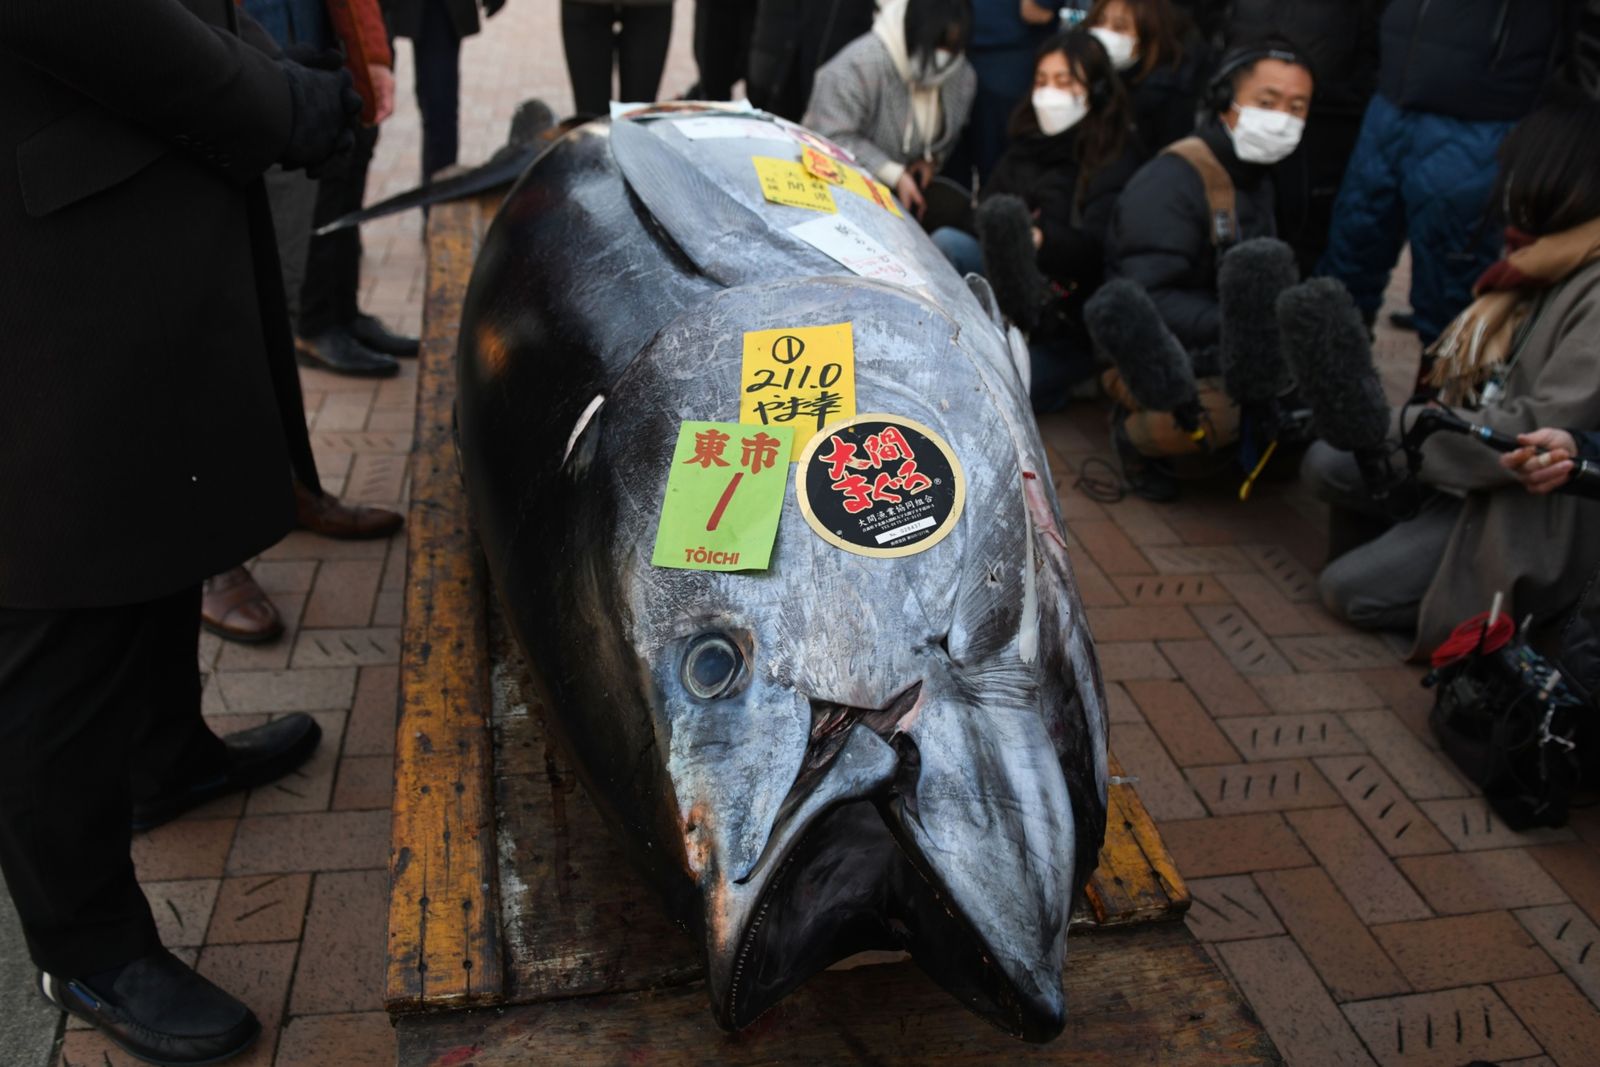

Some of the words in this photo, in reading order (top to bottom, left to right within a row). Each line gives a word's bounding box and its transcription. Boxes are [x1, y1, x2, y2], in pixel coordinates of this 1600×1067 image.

[746, 363, 842, 393] 211.0
[682, 429, 781, 475] 東市
[818, 426, 915, 481] 大間
[831, 459, 933, 514] まぐろ
[858, 494, 934, 527] 大間漁業協同組合
[684, 546, 741, 565] TŌICHI
